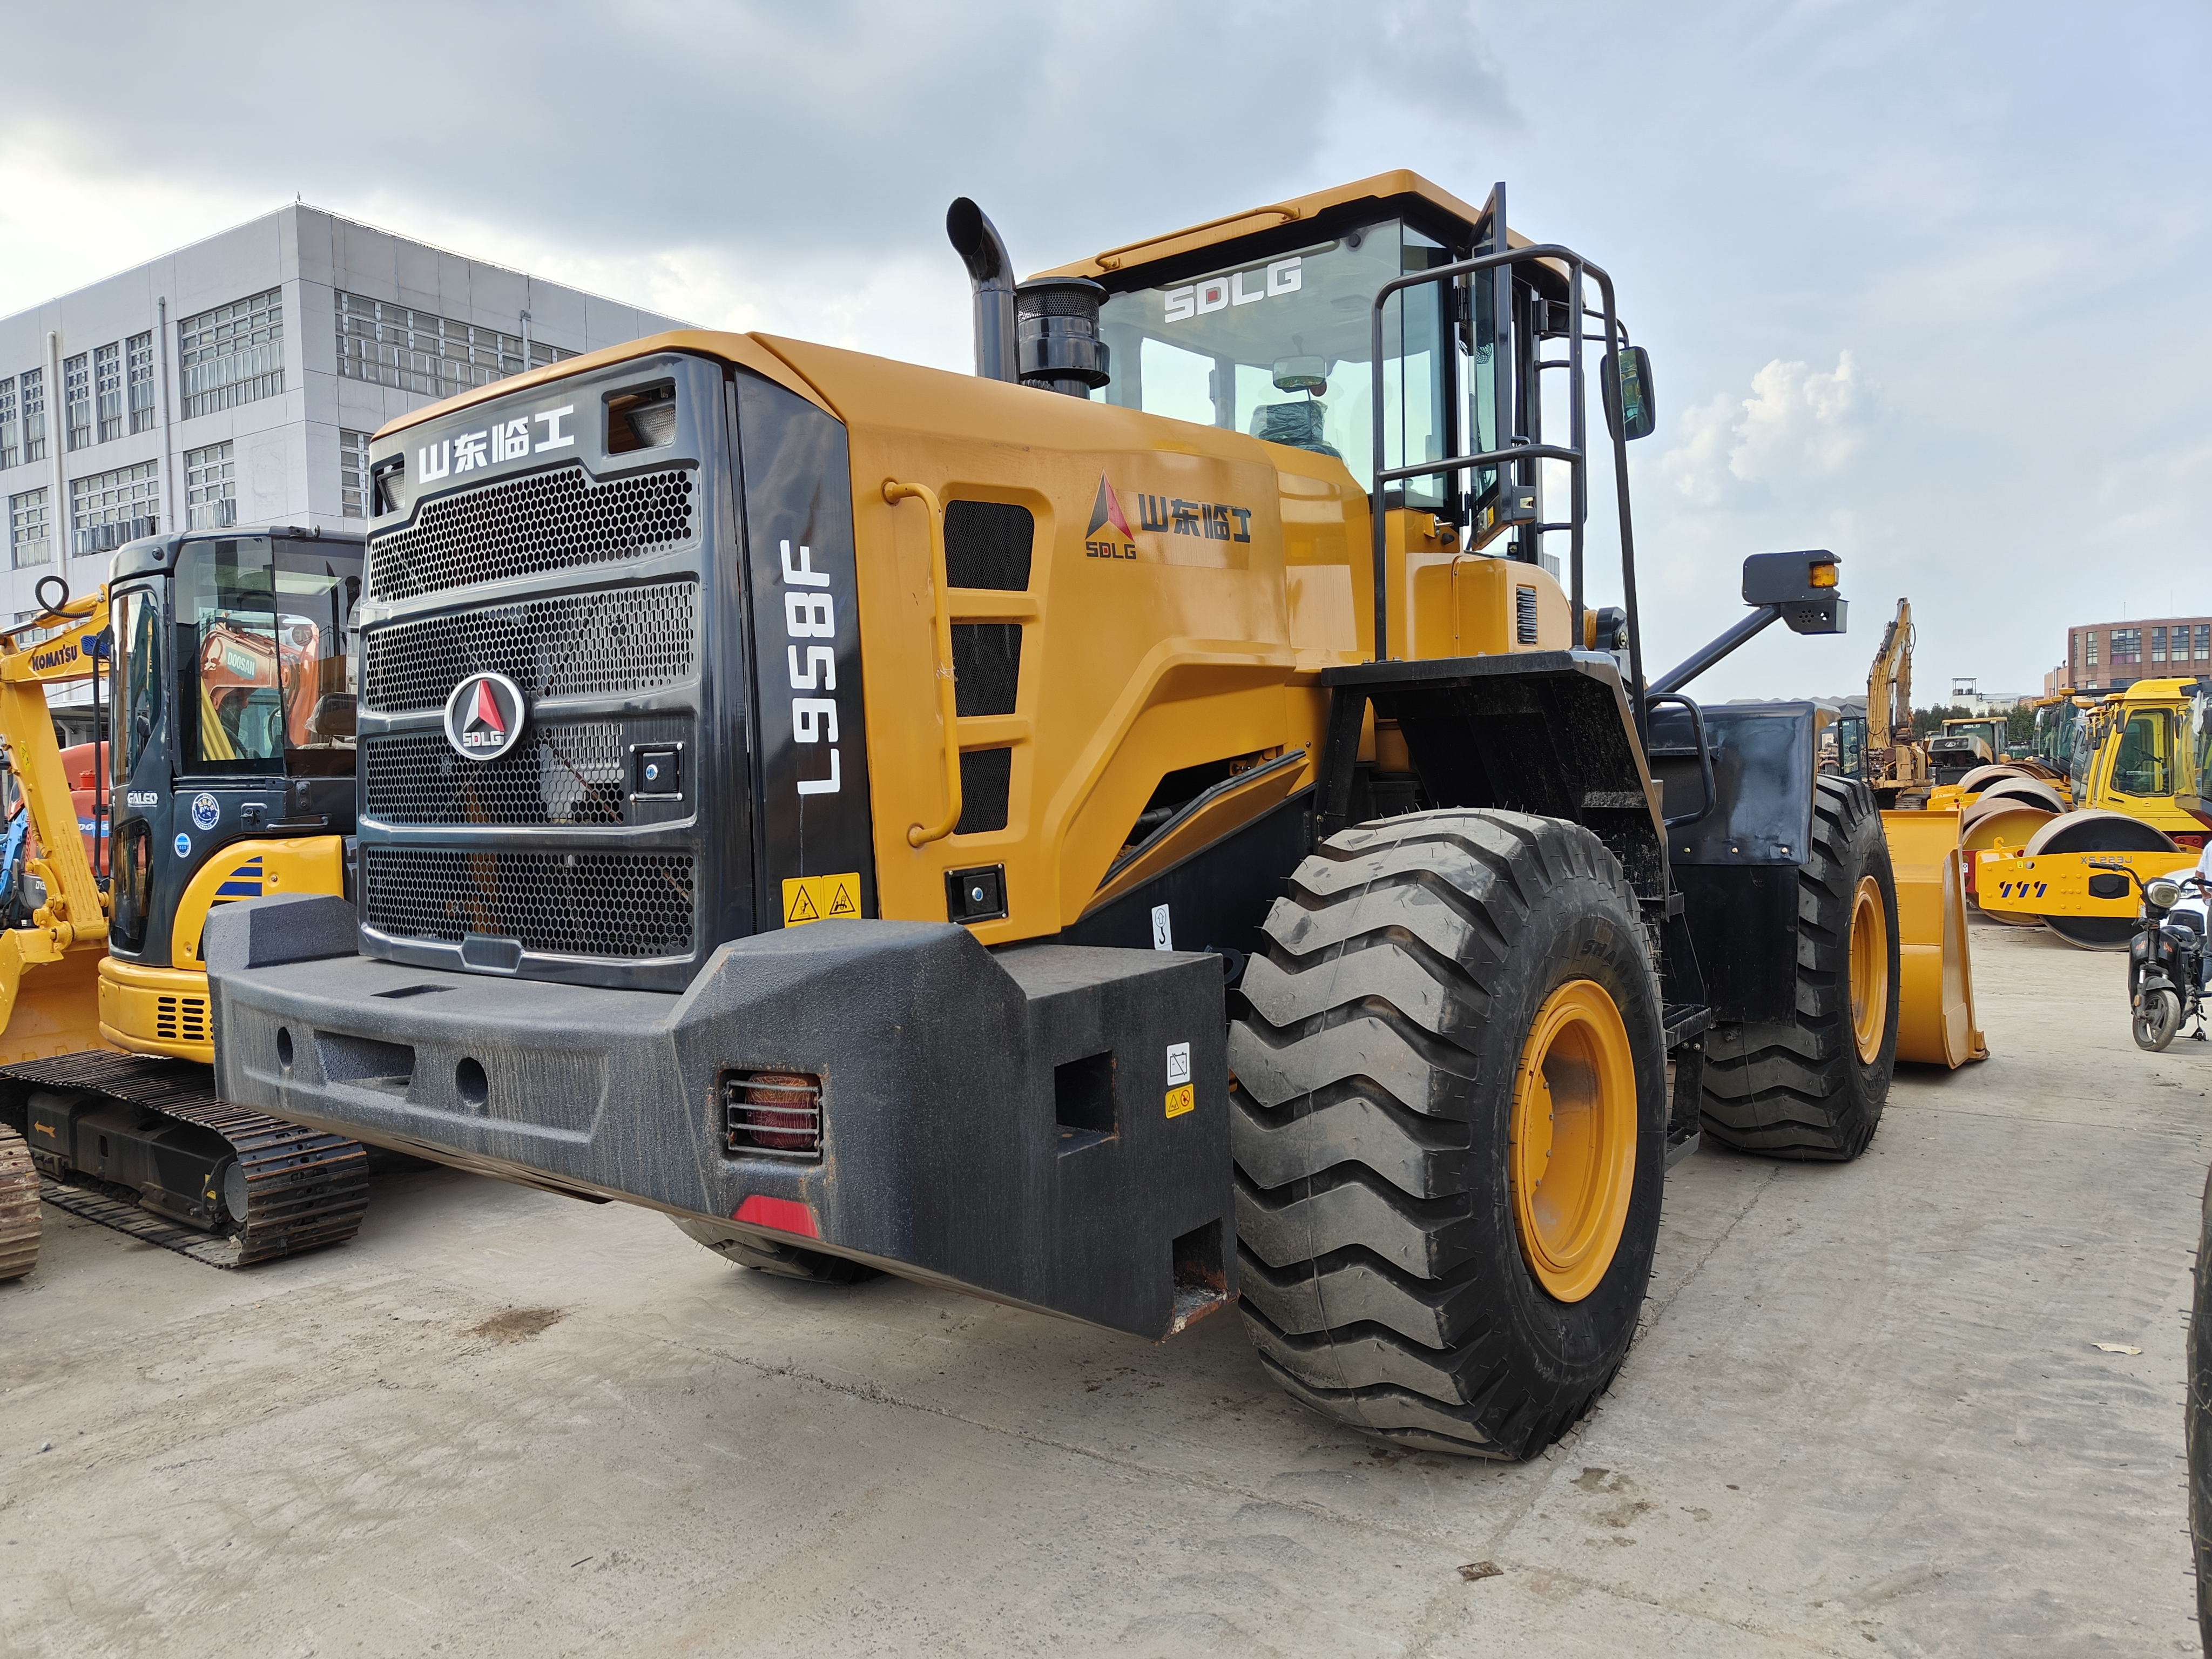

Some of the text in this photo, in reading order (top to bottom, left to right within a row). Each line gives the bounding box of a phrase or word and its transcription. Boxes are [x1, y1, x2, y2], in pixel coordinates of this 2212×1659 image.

[1164, 257, 1302, 323] SDLG
[418, 404, 575, 484] 山东临工
[1138, 493, 1251, 543] 山东临工
[1085, 541, 1136, 559] SDLG
[32, 644, 78, 671] KOMATSU
[227, 652, 255, 676] DOOSAN
[780, 539, 841, 795] L958F
[462, 730, 504, 747] SDLG
[127, 792, 158, 805] GALEO
